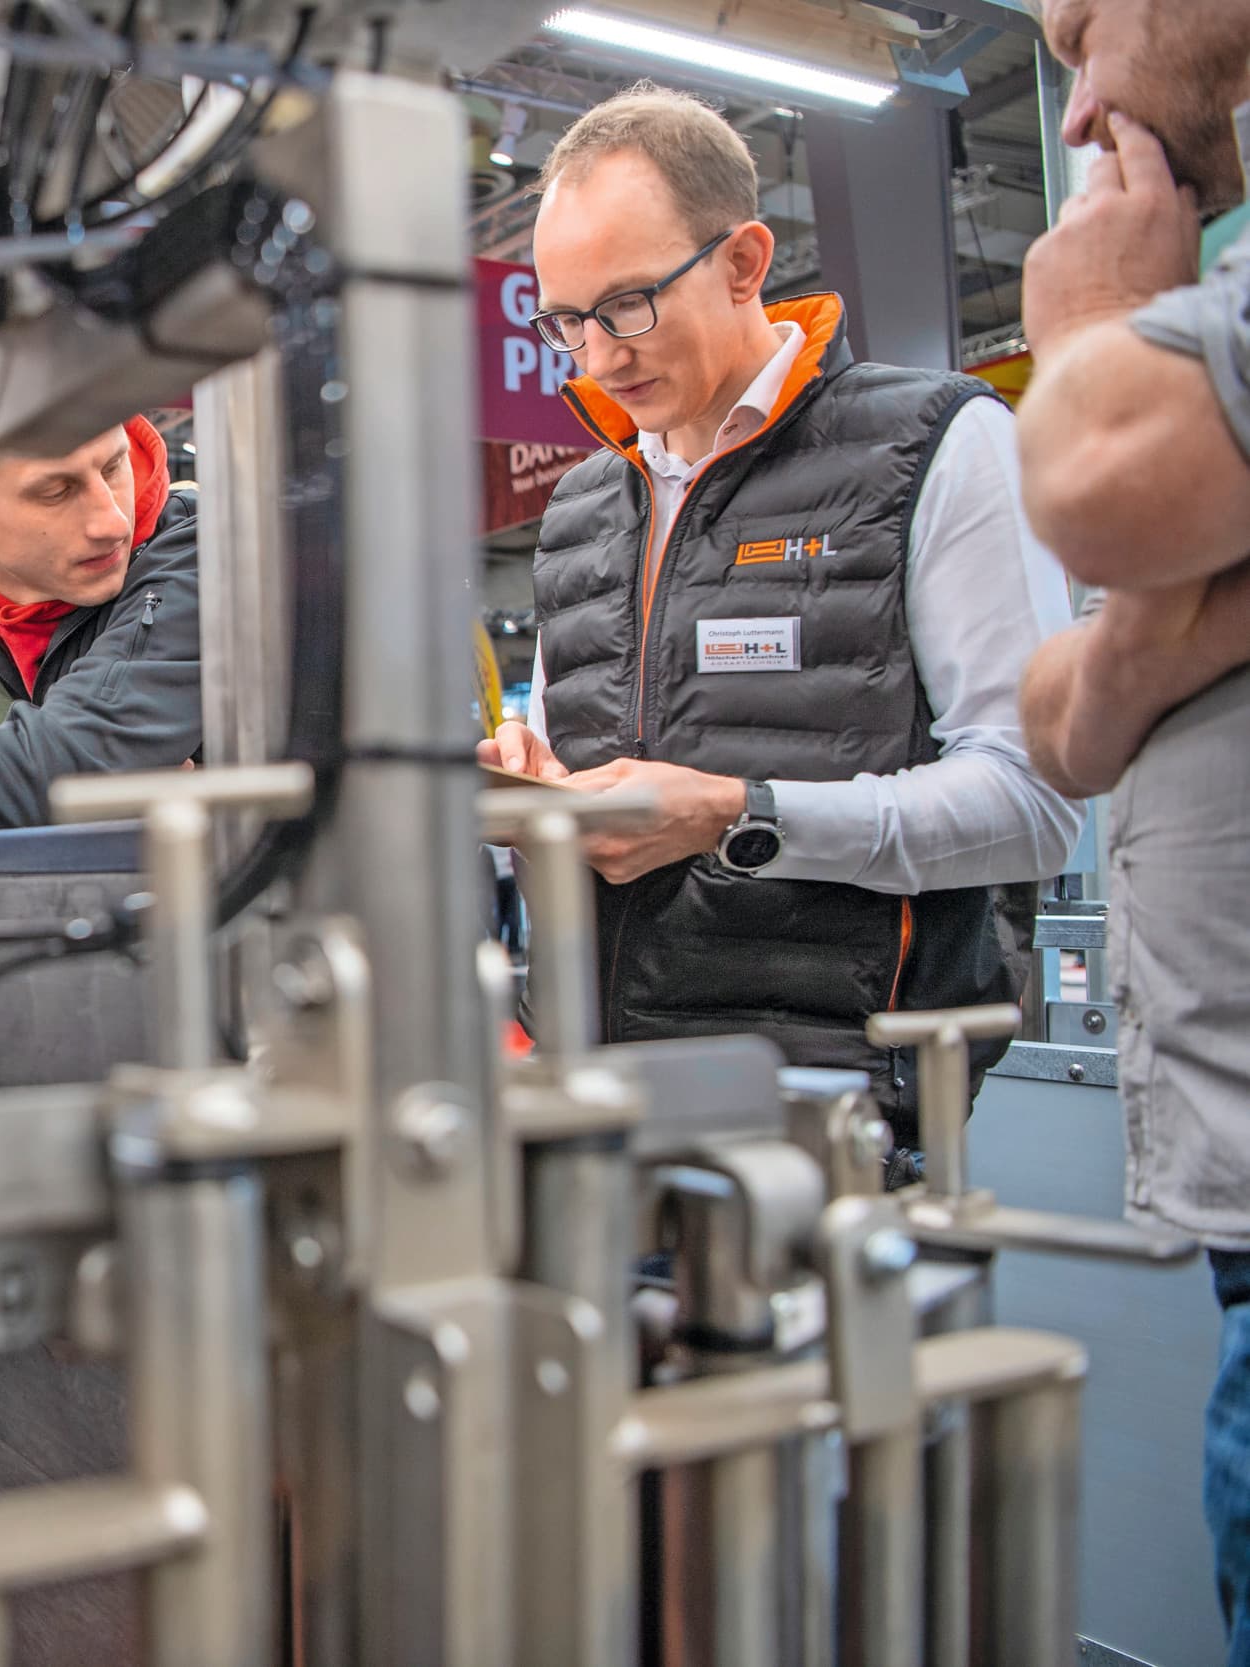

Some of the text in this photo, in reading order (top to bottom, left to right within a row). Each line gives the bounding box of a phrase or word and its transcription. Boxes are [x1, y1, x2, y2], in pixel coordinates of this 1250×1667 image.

[501, 272, 536, 329] G
[503, 336, 582, 396] PR
[708, 630, 741, 638] Christoph
